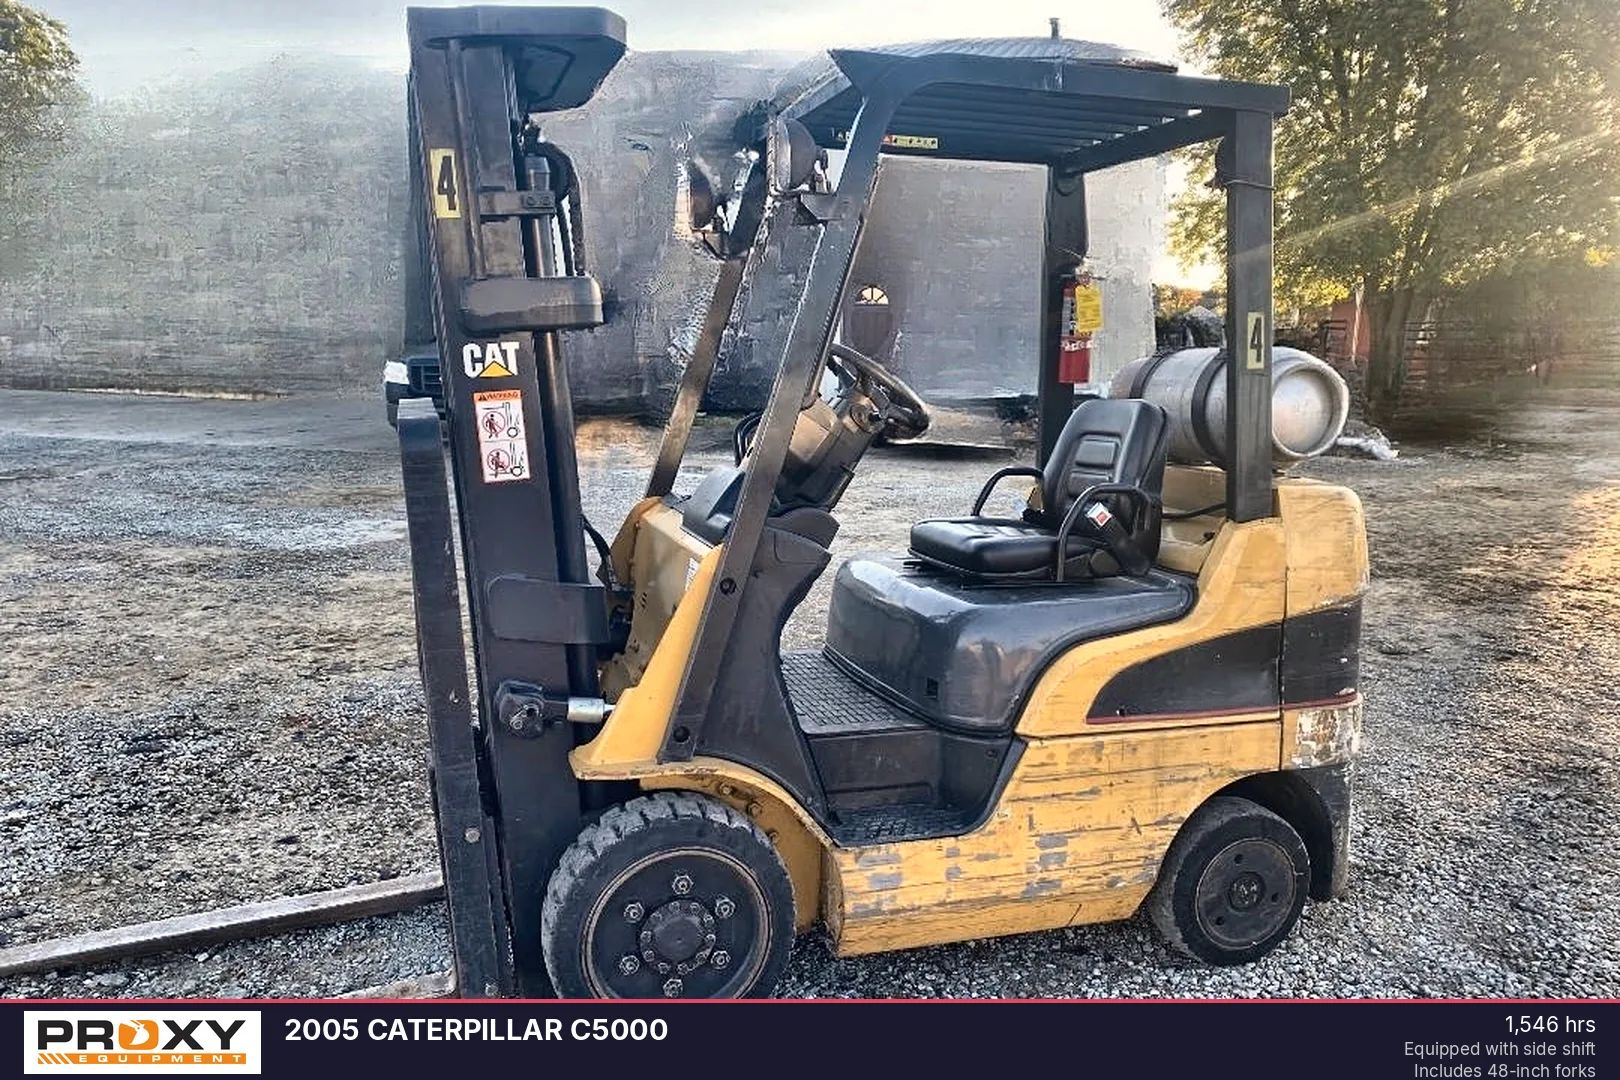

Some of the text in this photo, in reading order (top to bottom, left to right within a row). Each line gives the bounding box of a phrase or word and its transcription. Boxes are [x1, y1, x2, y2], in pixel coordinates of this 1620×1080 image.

[438, 156, 456, 210] 4
[463, 342, 519, 378] CAT
[1250, 317, 1262, 363] 4
